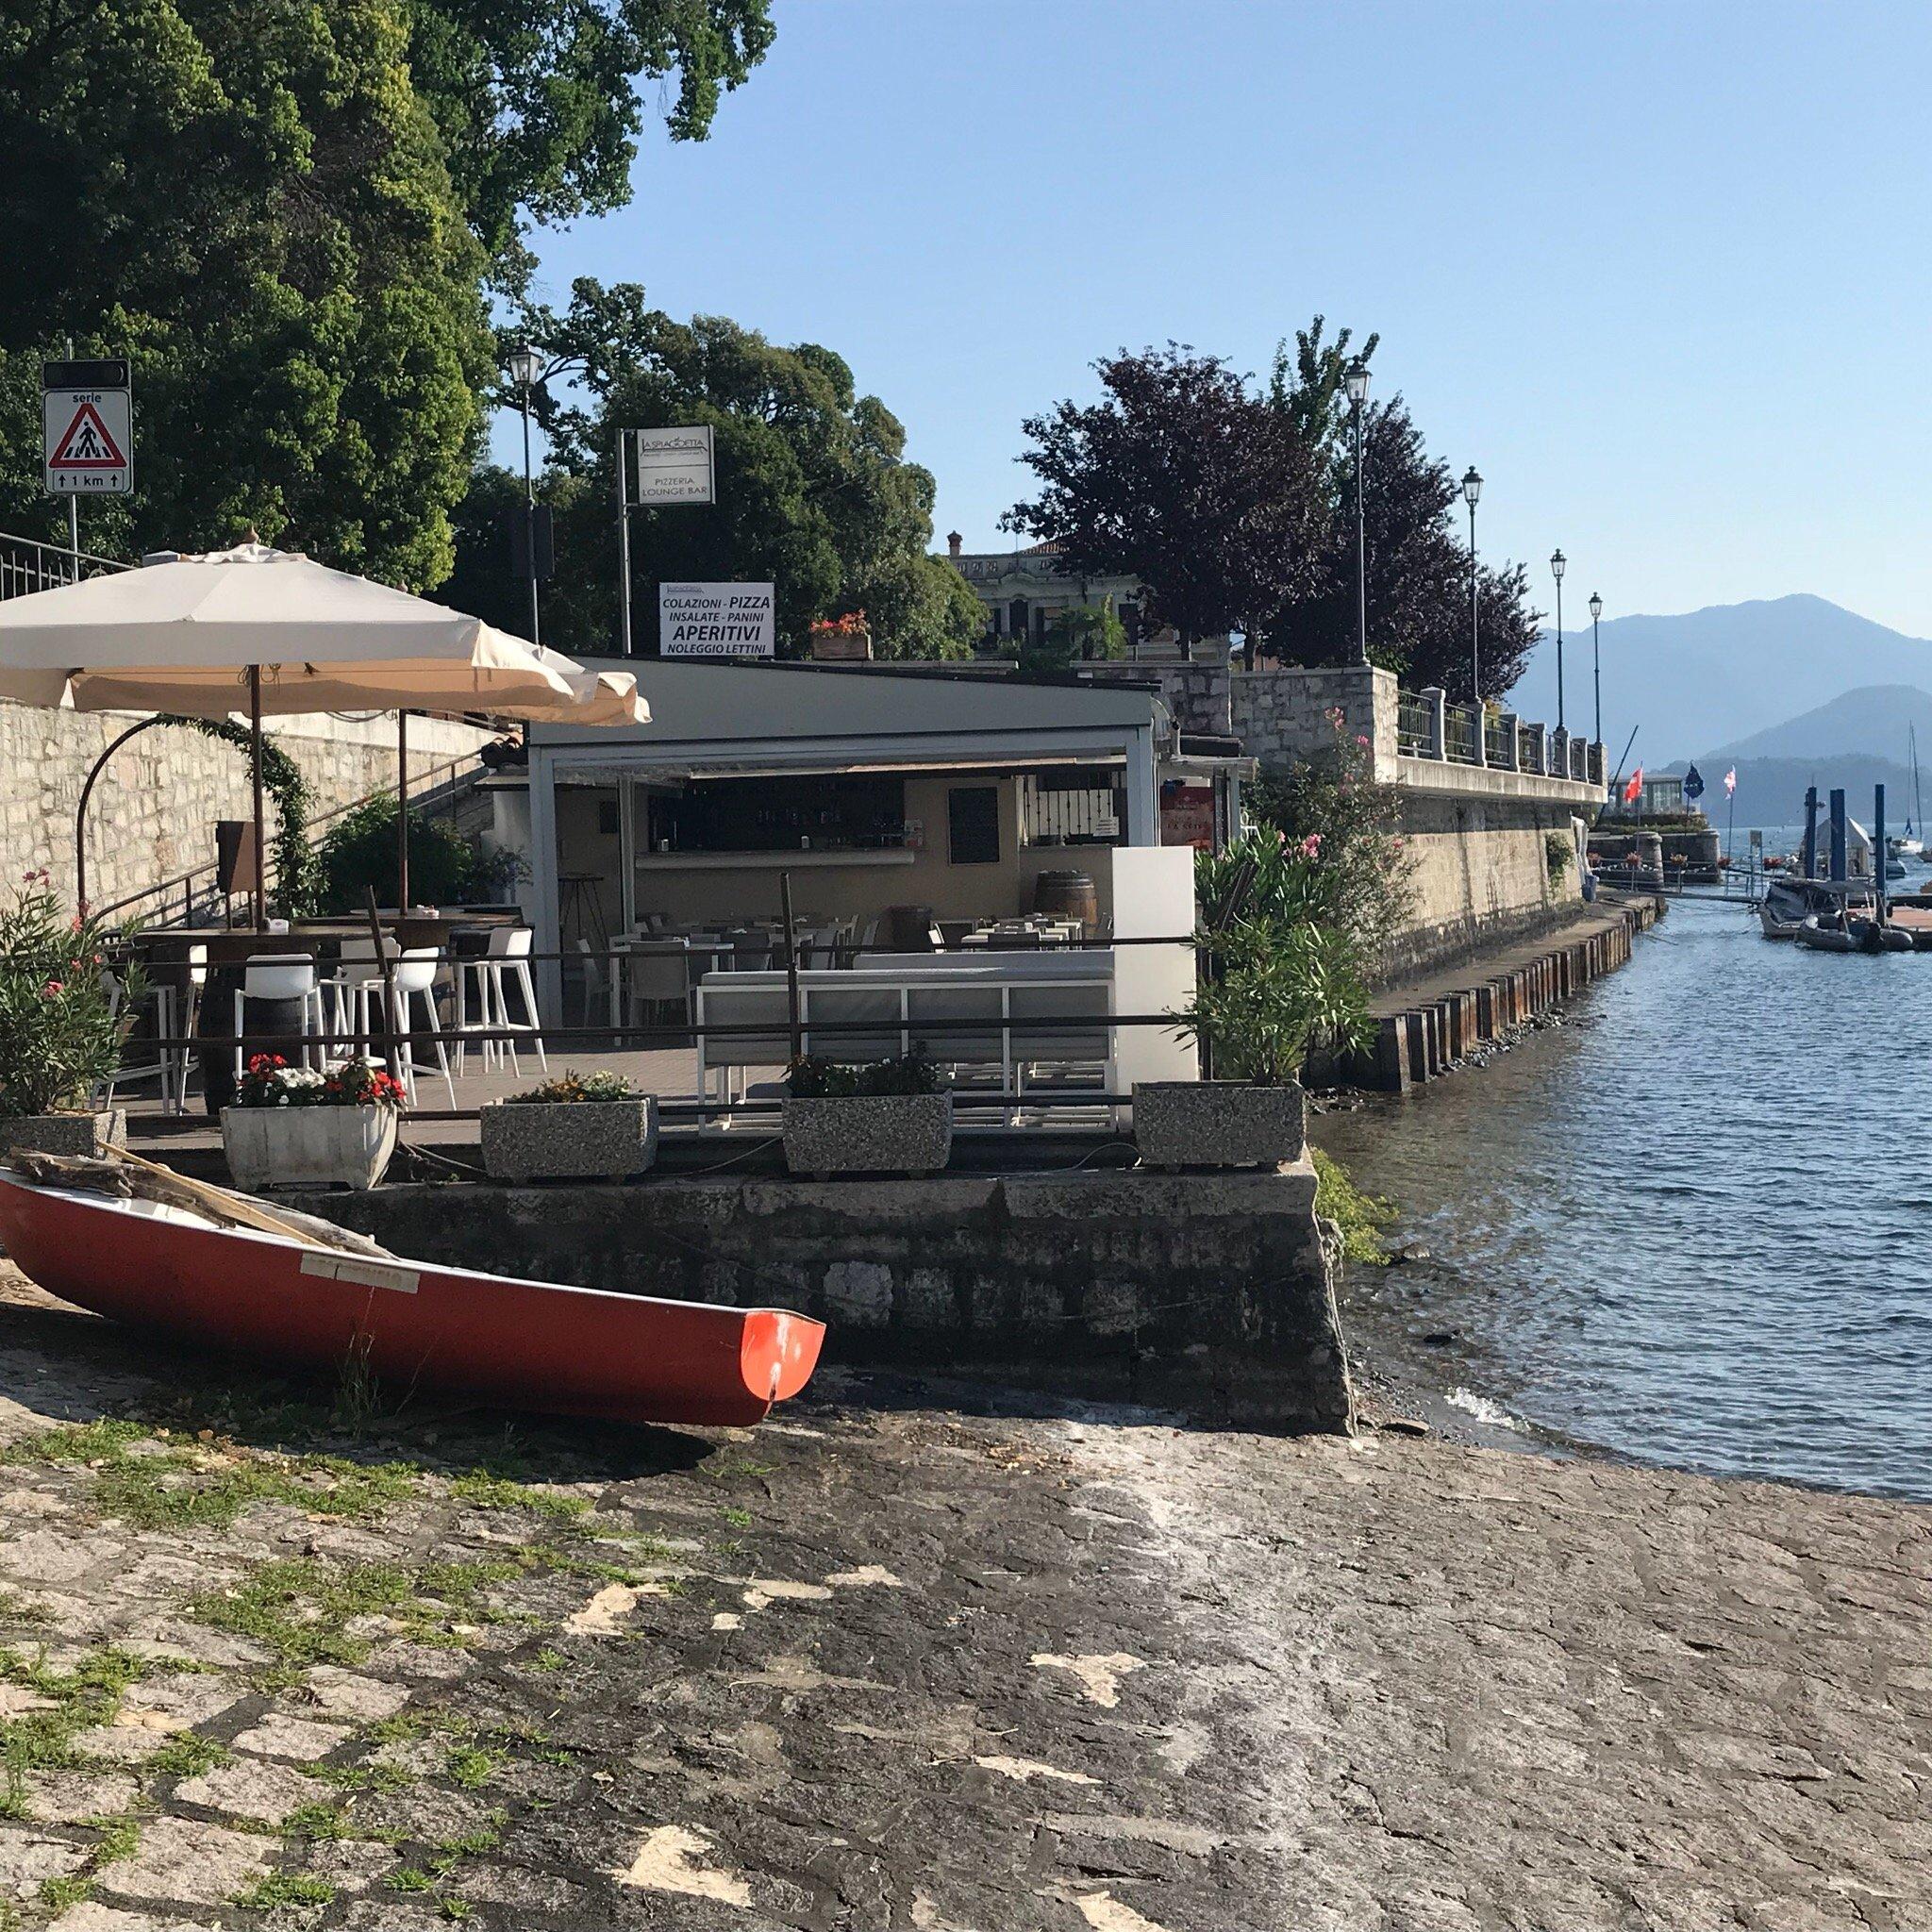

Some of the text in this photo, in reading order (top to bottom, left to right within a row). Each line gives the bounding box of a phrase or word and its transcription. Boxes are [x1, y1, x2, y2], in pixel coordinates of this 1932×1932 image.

[73, 391, 102, 403] serie
[73, 475, 104, 487] 1 km
[655, 477, 694, 486] PIZZERIA
[642, 487, 708, 496] LOUNGE BAR
[662, 598, 722, 608] COLAZIONI
[729, 596, 771, 608] PIZZA
[669, 612, 721, 623] INSALATE
[727, 612, 765, 623] PANINI
[673, 625, 761, 641] APERITIVI
[667, 643, 767, 654] NOLEGGIO LETTINI
